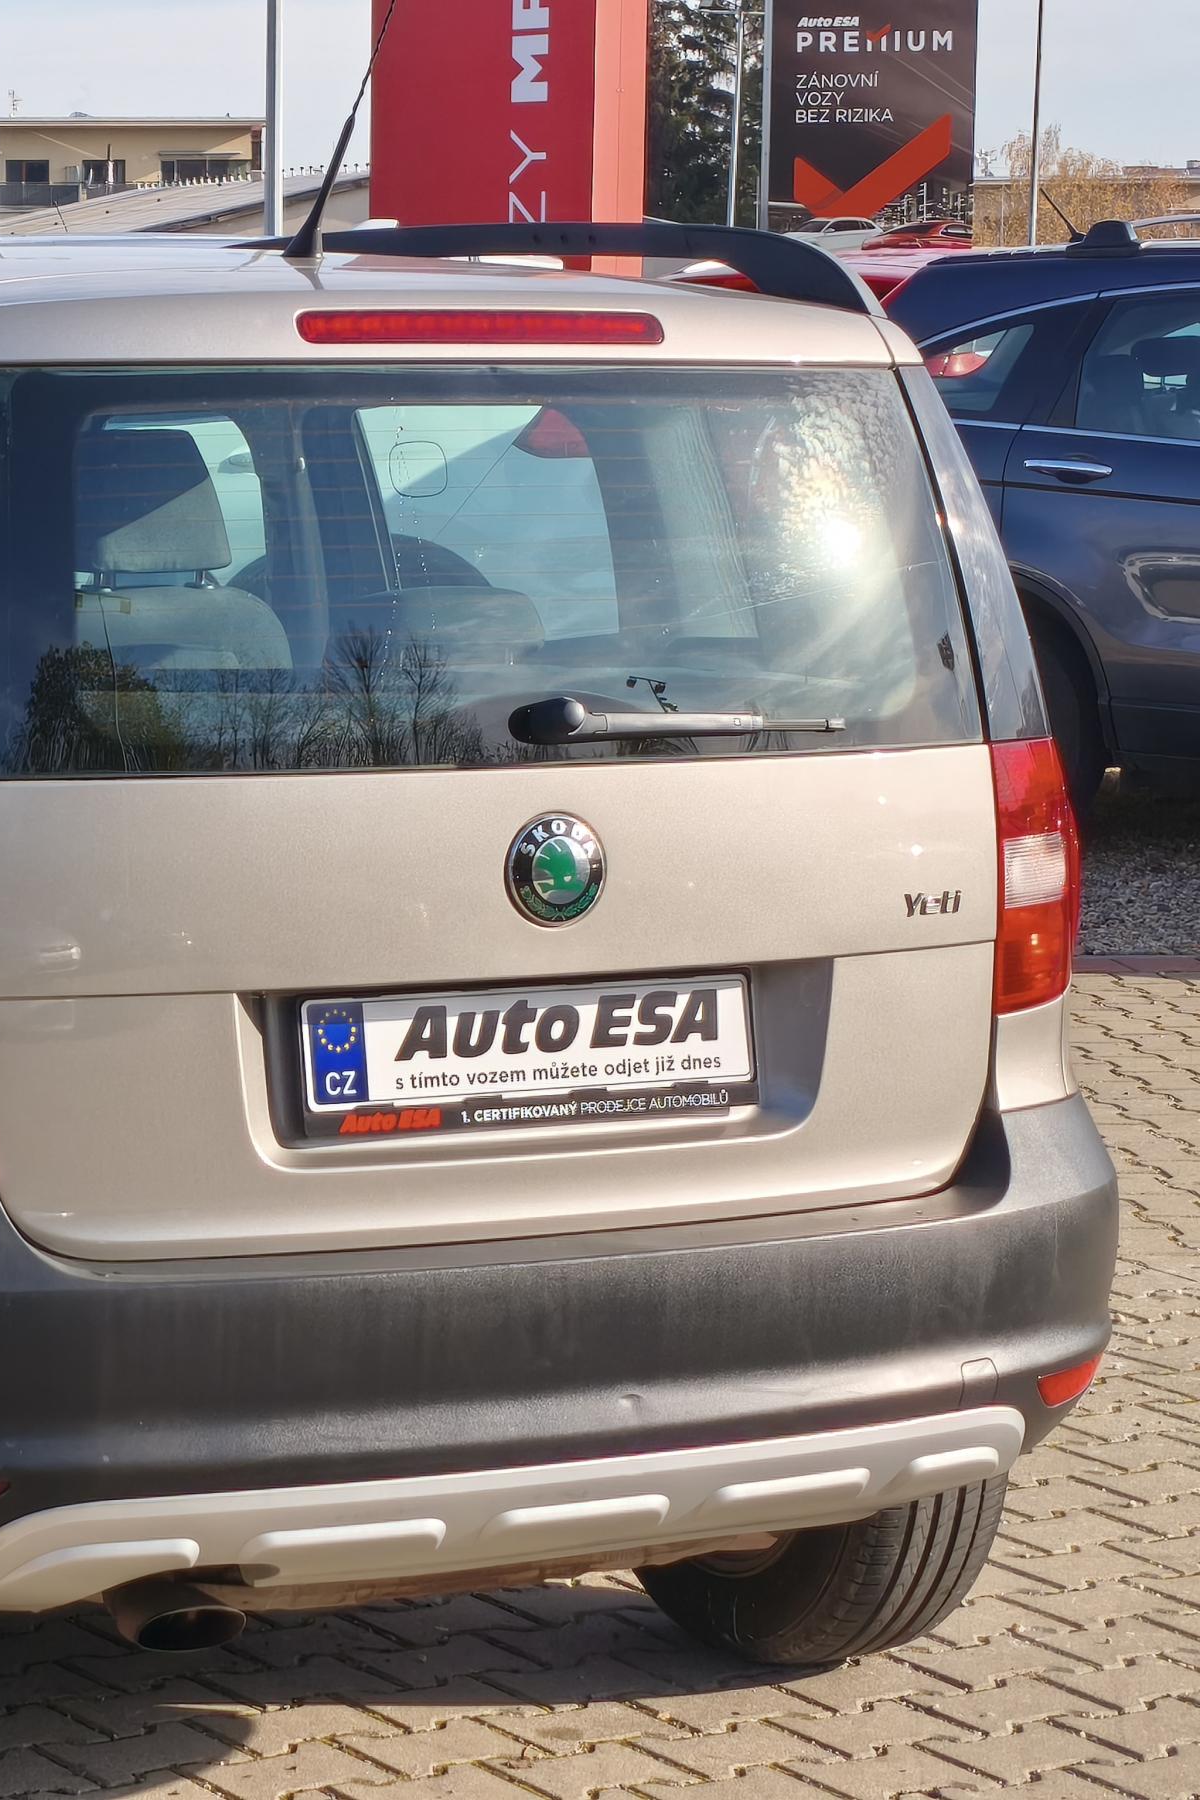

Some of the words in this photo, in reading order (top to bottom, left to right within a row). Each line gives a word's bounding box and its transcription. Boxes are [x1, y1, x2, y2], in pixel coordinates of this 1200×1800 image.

[796, 27, 953, 53] PREMIUM
[795, 71, 879, 89] ZÁNOVNÍ
[795, 92, 845, 106] VOZY
[795, 109, 829, 124] BEZ
[835, 108, 894, 123] RIZIKA
[904, 889, 962, 917] Yeti
[394, 998, 580, 1061] Auto
[589, 989, 718, 1048] ESA
[325, 1070, 357, 1095] CZ
[395, 1077, 404, 1090] s
[410, 1071, 460, 1089] tímto
[466, 1068, 526, 1086] vozem
[533, 1061, 598, 1080] můžete
[604, 1058, 650, 1076] odjet
[655, 1055, 675, 1075] již
[680, 1054, 721, 1071] dnes
[461, 1110, 471, 1124] 1.
[474, 1100, 577, 1122] CERTIFIKOVANÝ
[580, 1097, 647, 1115] PRODEJCE
[649, 1088, 729, 1110] AUTOMOBILŮ
